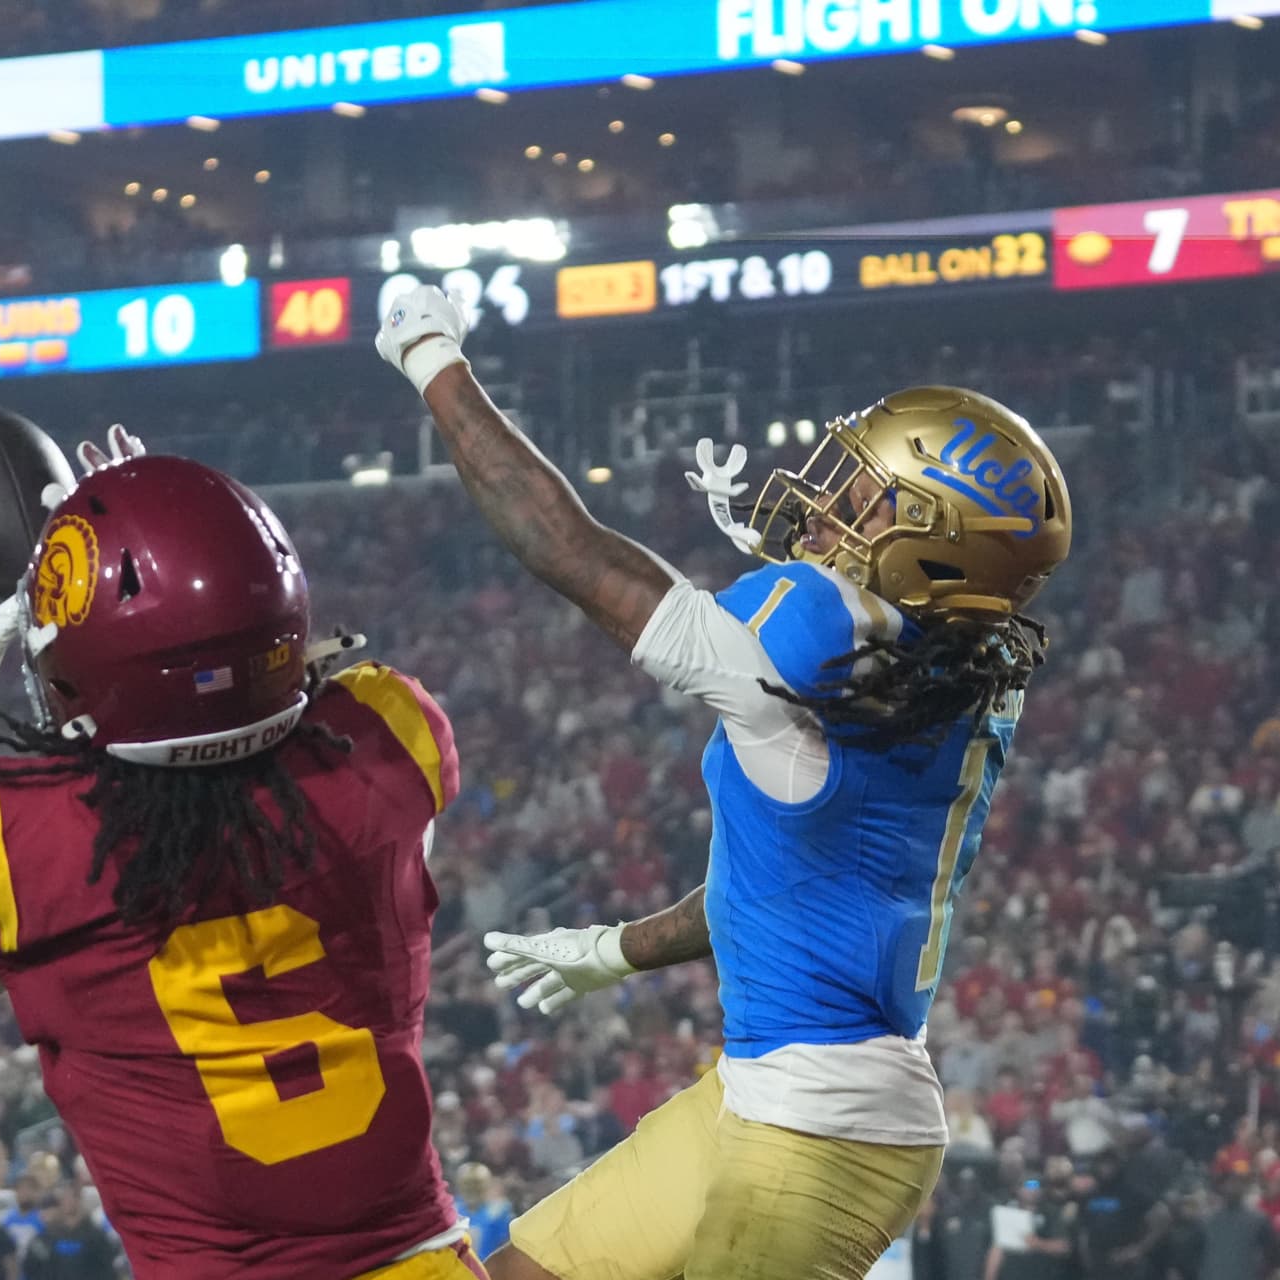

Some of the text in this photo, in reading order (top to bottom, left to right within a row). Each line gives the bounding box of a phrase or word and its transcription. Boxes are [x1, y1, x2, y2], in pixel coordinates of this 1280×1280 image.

[244, 42, 442, 93] UNITED
[1143, 208, 1189, 274] 7
[778, 250, 832, 295] 10
[860, 251, 938, 289] BALL
[938, 246, 992, 282] ON
[117, 294, 195, 358] 10
[276, 289, 342, 337] 40
[170, 735, 256, 763] FIGHT
[148, 903, 386, 1166] 6
